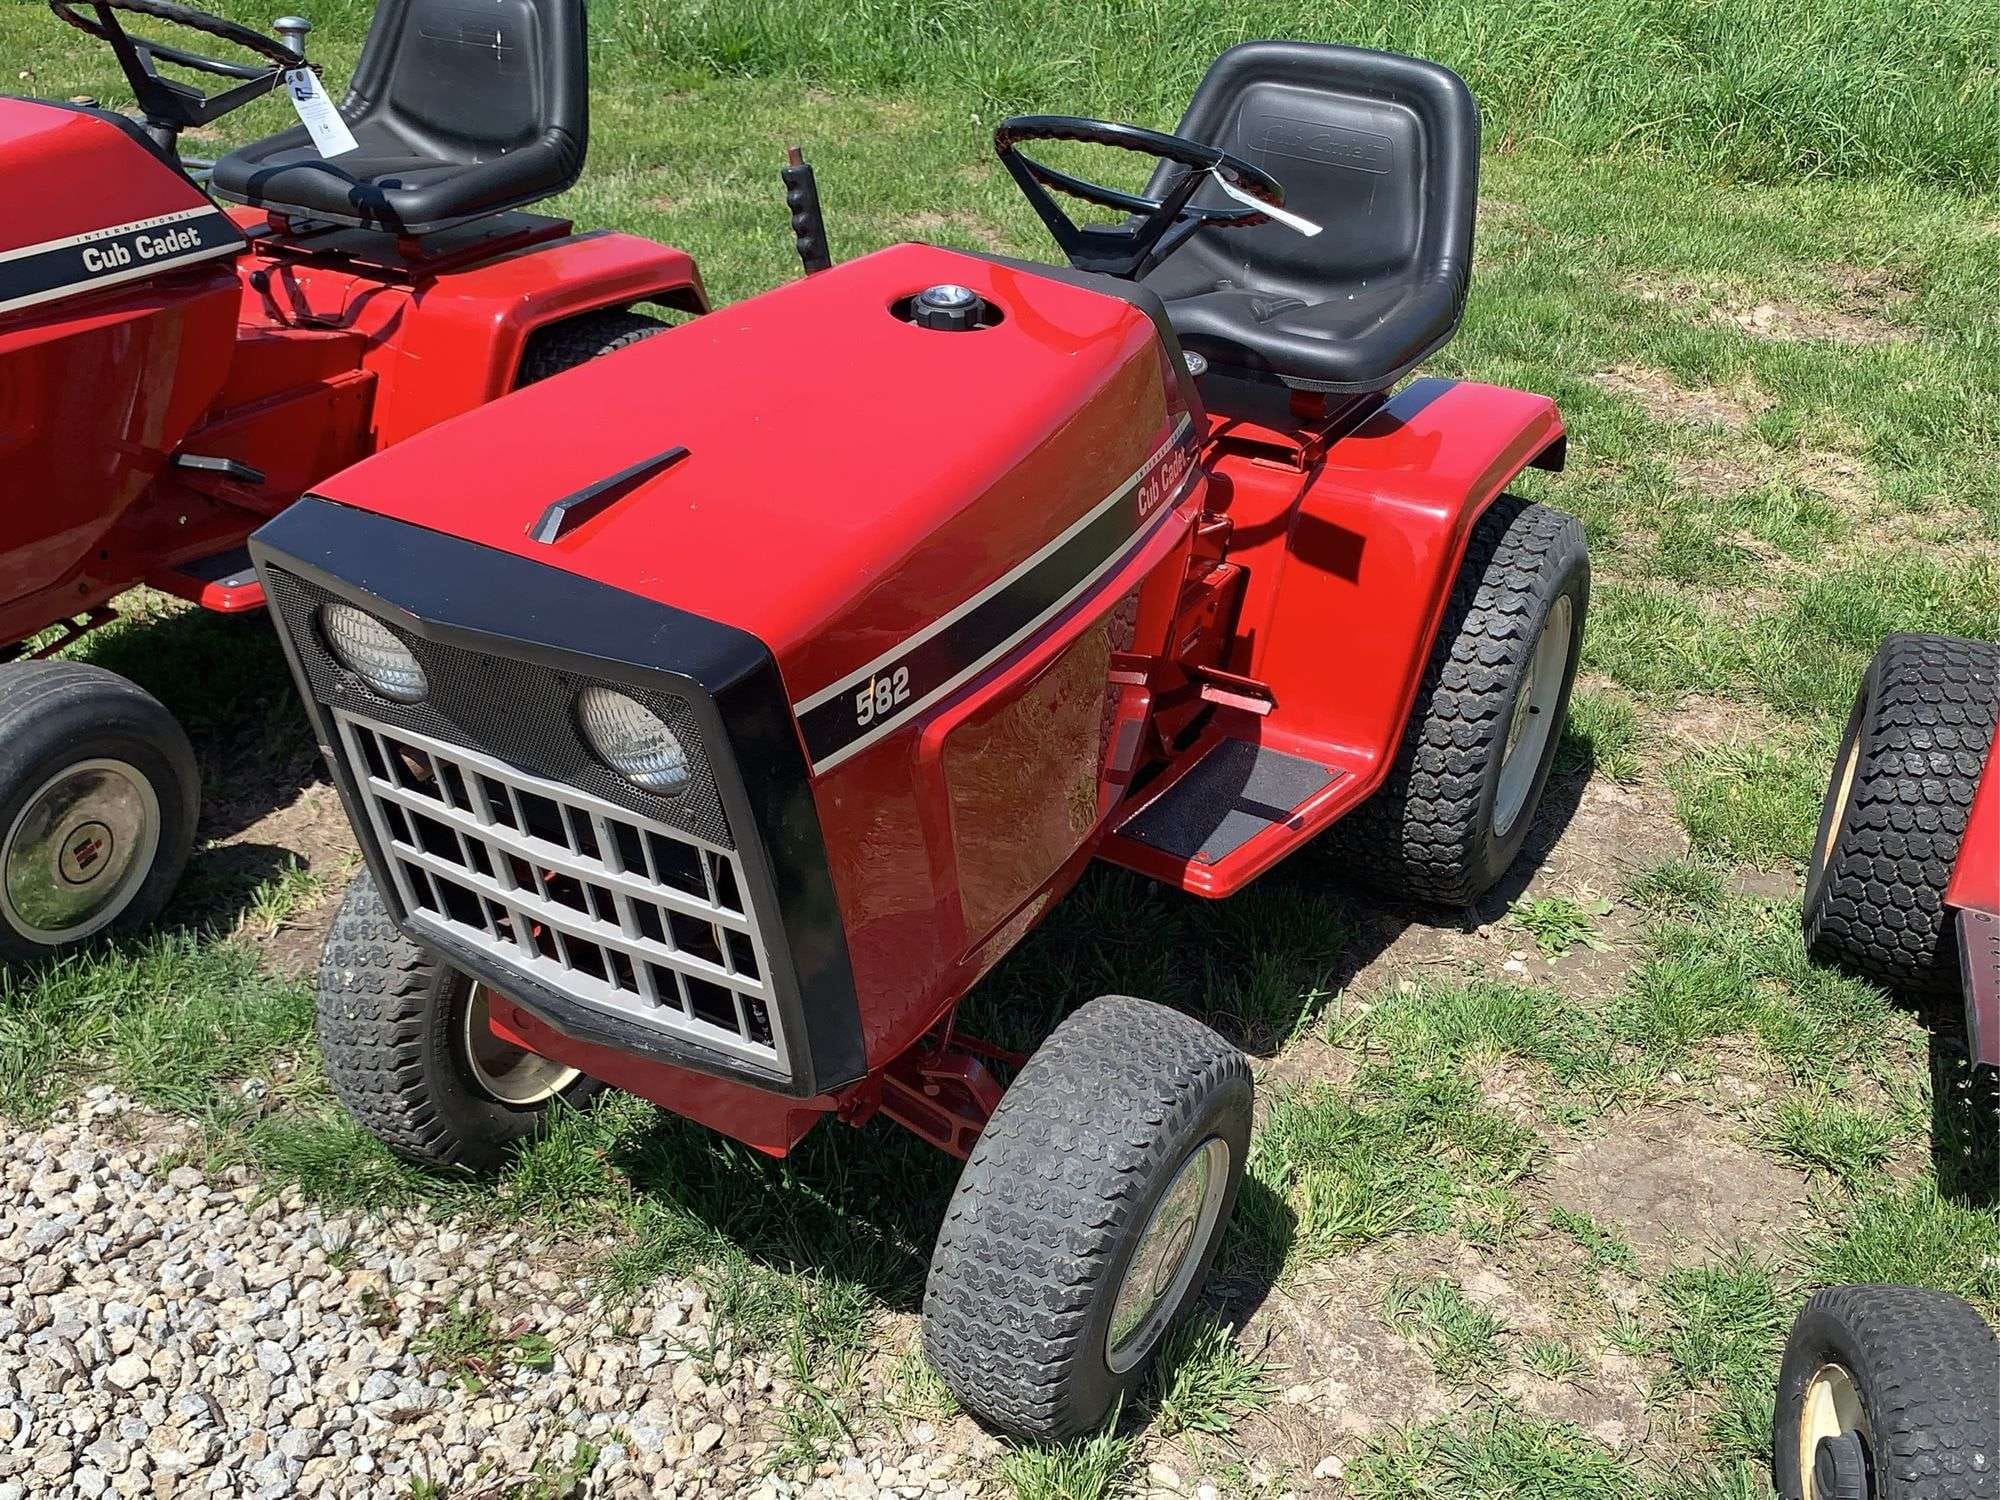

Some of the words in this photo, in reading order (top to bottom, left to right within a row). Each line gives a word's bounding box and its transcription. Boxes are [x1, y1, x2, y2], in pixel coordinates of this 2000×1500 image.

[77, 213, 191, 242] INTERNATIONAL
[83, 243, 131, 272] Cub
[136, 228, 202, 259] Cadet
[1138, 476, 1160, 516] Cub
[1161, 446, 1187, 492] Cadet
[856, 666, 910, 726] 582
